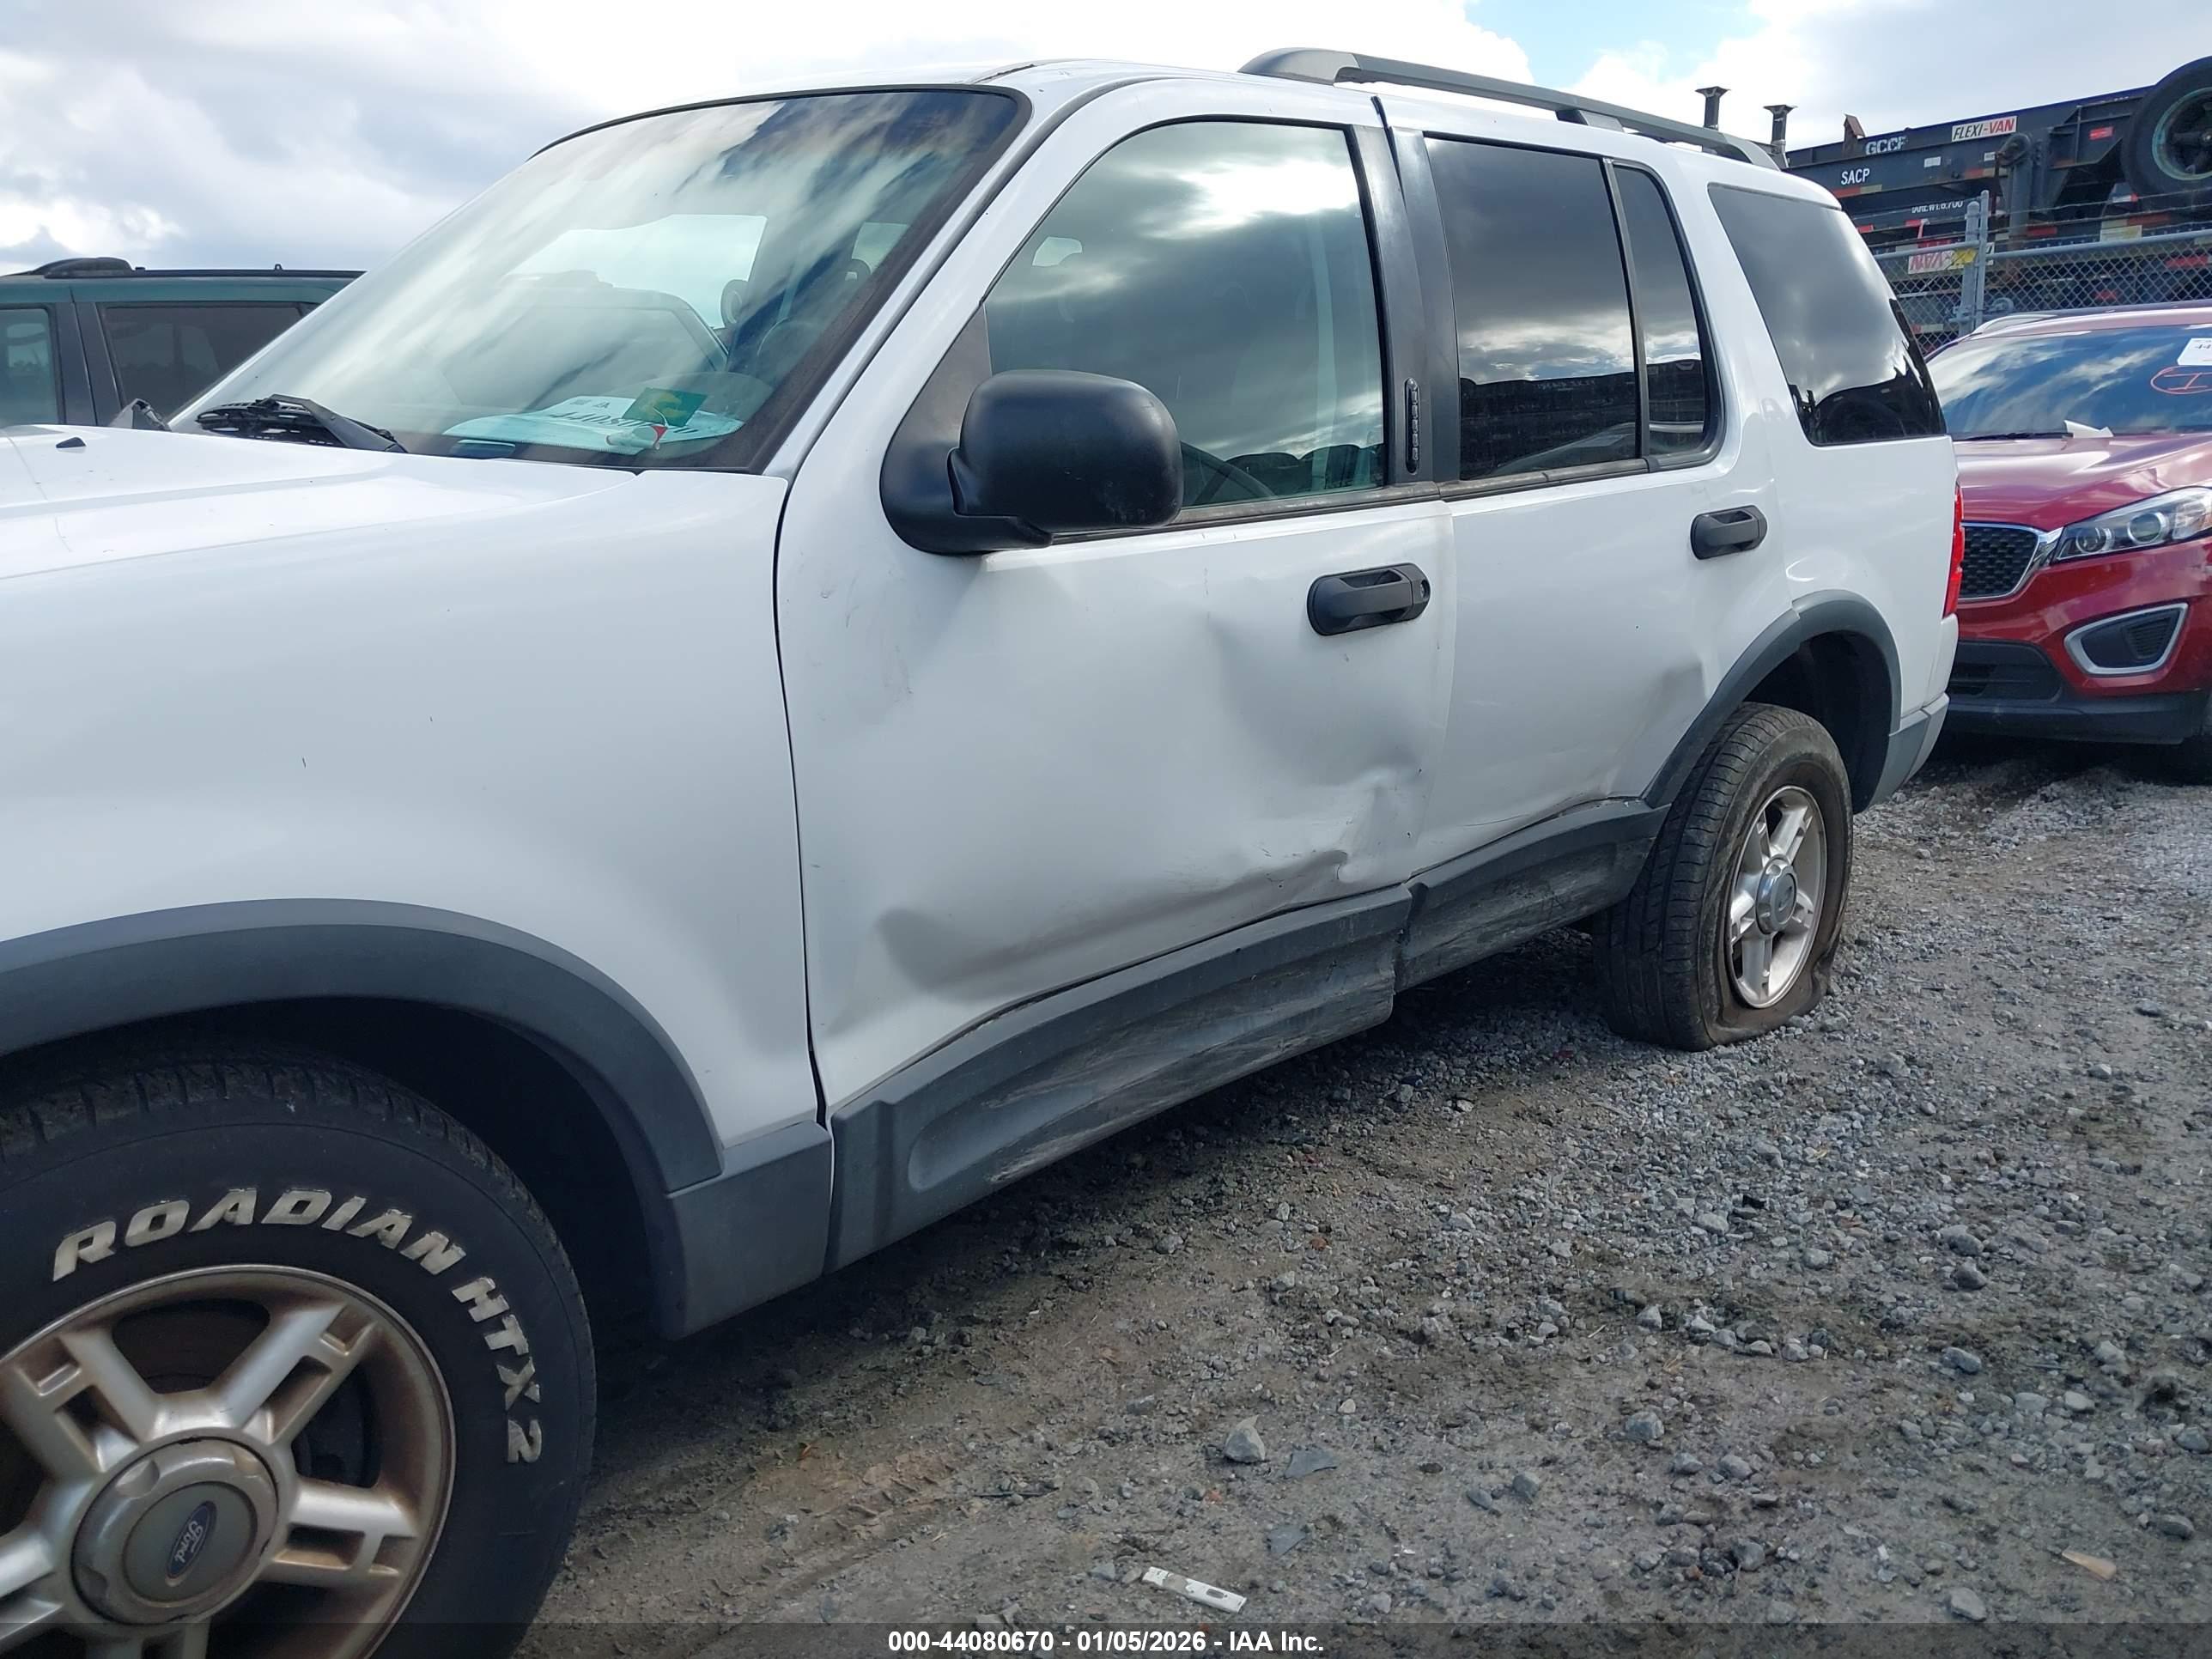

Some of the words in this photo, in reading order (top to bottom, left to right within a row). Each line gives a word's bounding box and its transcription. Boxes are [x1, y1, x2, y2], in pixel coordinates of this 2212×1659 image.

[1953, 118, 2014, 139] FLEXI-VAN
[1841, 168, 1869, 185] SACP
[52, 1188, 467, 1282] ROADIAN
[173, 1521, 204, 1563] Ford
